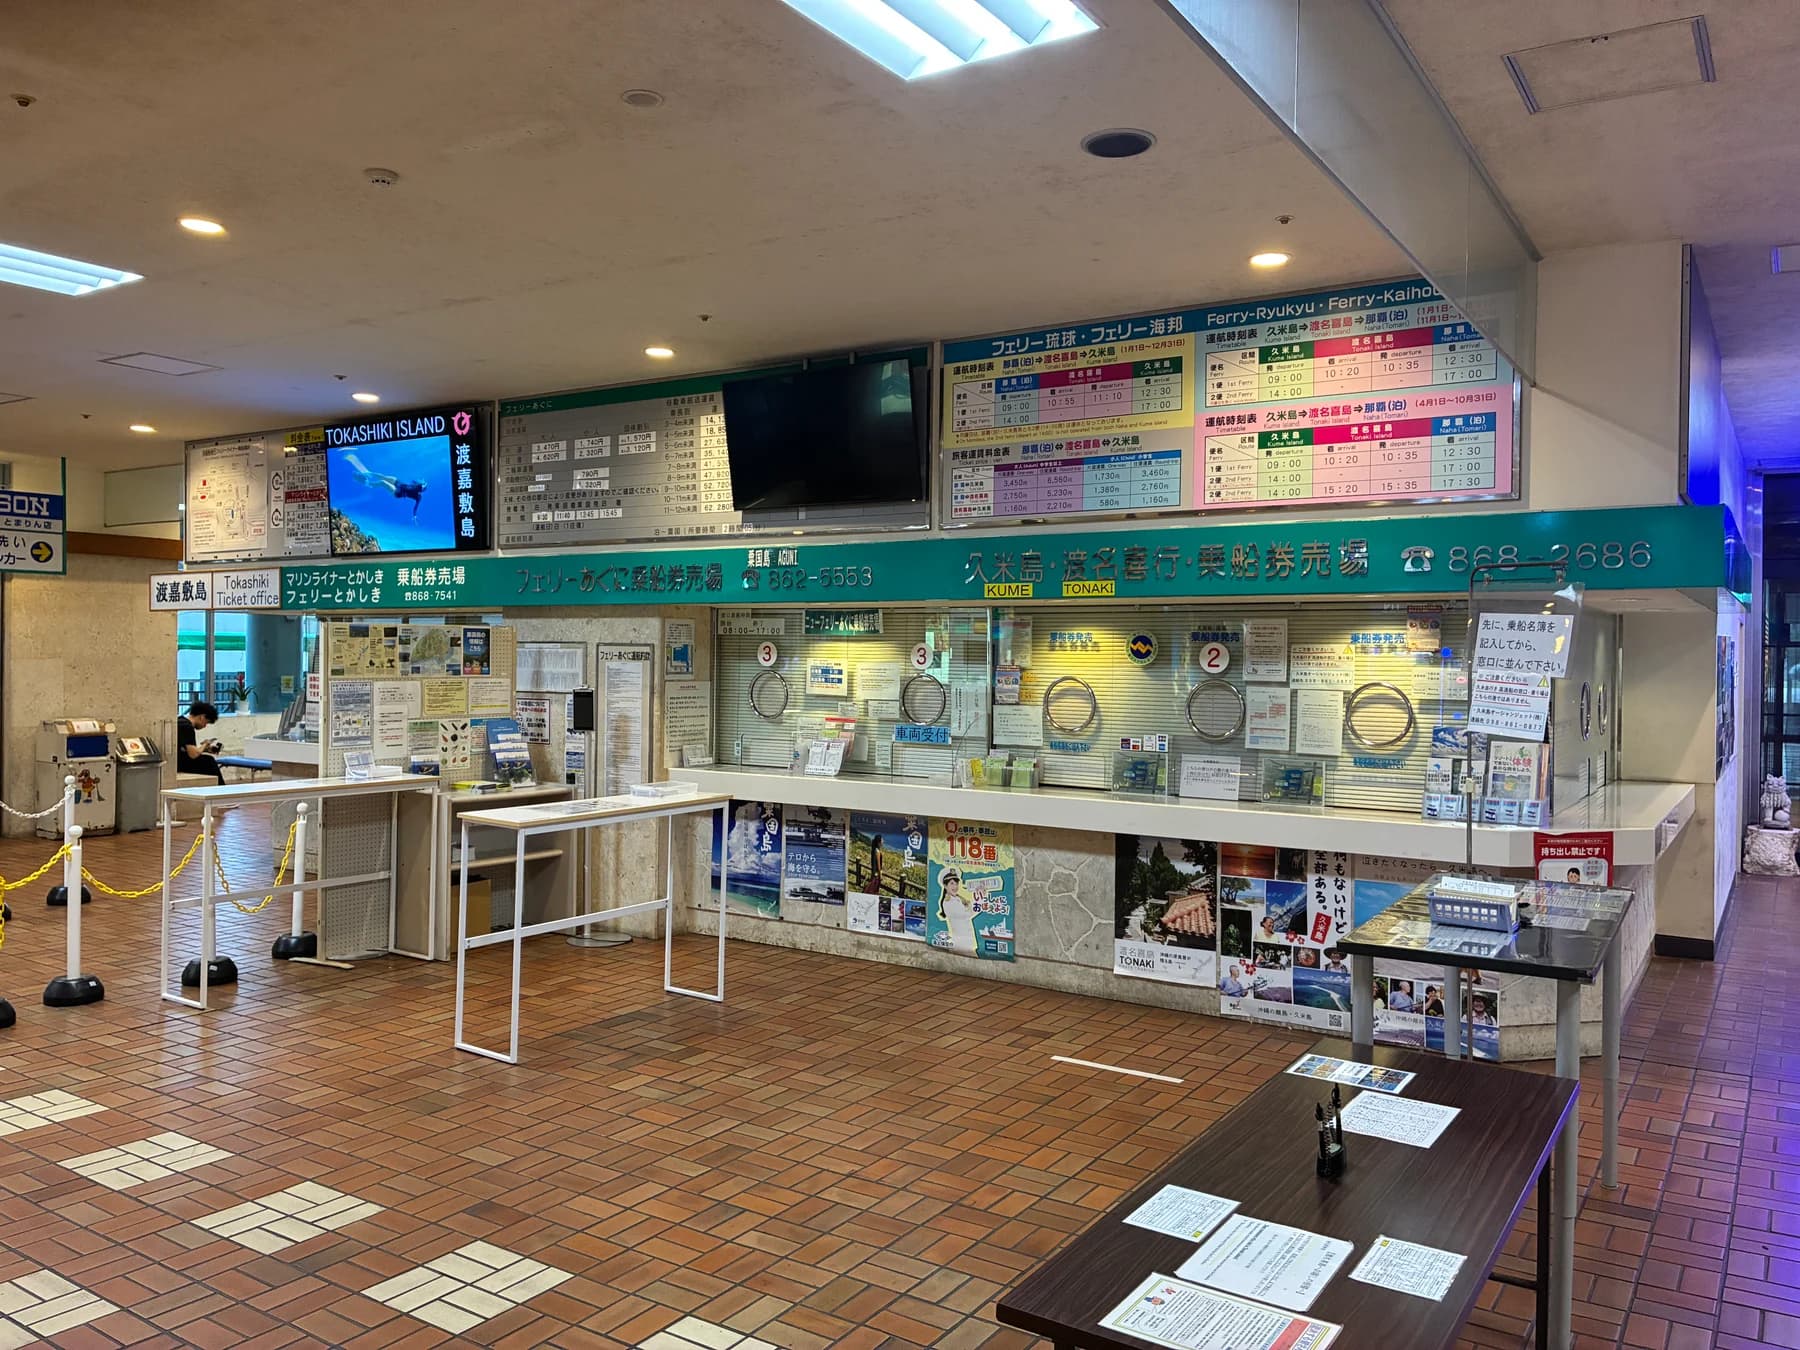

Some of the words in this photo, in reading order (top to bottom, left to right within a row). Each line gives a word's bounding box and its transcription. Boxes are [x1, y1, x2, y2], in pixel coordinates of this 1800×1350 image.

[1208, 302, 1315, 326] Ferry-Ryukyu
[991, 316, 1184, 357] フェリー琉球・フェリー海邦
[1205, 328, 1258, 344] 運航時刻表
[1266, 324, 1298, 337] 久米島
[1309, 316, 1353, 332] 渡名喜島
[1364, 308, 1408, 325] 那覇(泊)
[1216, 341, 1247, 349] Timetable
[1264, 336, 1282, 344] Kume
[1284, 333, 1301, 341] Island
[1311, 330, 1331, 338] Tonaki
[1333, 327, 1351, 335] Island
[953, 361, 995, 375] 運航時刻表
[1088, 346, 1116, 358] 久米島
[1271, 346, 1300, 356] 久米島
[1268, 373, 1302, 384] 09:00
[1325, 367, 1359, 378] 10:20
[1384, 361, 1419, 372] 10:35
[1445, 353, 1482, 365] 12:30
[1269, 387, 1302, 398] 14:00
[1445, 369, 1482, 381] 17:00
[1002, 402, 1030, 412] 09:00
[1047, 396, 1076, 407] 10:55
[1093, 391, 1122, 403] 11:10
[1141, 387, 1171, 397] 12:30
[1003, 414, 1030, 425] 14:00
[1141, 400, 1171, 411] 17:00
[1205, 413, 1257, 427] 運航時刻表
[1265, 410, 1298, 422] 久米島
[1308, 405, 1351, 418] 渡名喜島
[1364, 399, 1407, 414] 那覇(泊)
[325, 421, 393, 446] TOKASHIKI
[396, 415, 446, 438] ISLAND
[1264, 421, 1282, 429] Kume
[1440, 425, 1487, 434] Naha(Tomari)
[1111, 435, 1140, 447] 久米島
[1240, 436, 1255, 444] 区間
[1271, 432, 1300, 441] 久米島
[1267, 459, 1302, 469] 09:00
[1324, 455, 1358, 465] 10:20
[1382, 451, 1418, 461] 10:35
[1443, 447, 1481, 457] 12:30
[1268, 473, 1301, 483] 14:00
[1443, 462, 1481, 472] 17:00
[455, 443, 476, 538] 渡嘉敷島
[1268, 487, 1301, 497] 14:00
[1324, 484, 1358, 494] 15:20
[1382, 481, 1418, 491] 15:35
[1443, 477, 1481, 487] 17:30
[777, 549, 799, 567] AGUNI
[964, 538, 1370, 586] 久米島・渡名喜行・乗船券売場
[1448, 540, 1652, 574] 868-2686
[156, 579, 207, 605] 渡嘉敷島
[224, 573, 270, 590] Tokashiki
[286, 568, 384, 586] マリンライナーとかしき
[397, 567, 466, 586] 乗船券売場
[514, 562, 724, 594] フェリーあぐに乗船券売場
[216, 591, 249, 606] Ticket
[250, 590, 280, 606] office
[286, 586, 382, 605] フェリーとかしき
[986, 583, 1030, 597] KUME
[1064, 582, 1115, 595] TONAKI
[1481, 618, 1556, 633] 先に、乗船名簿を
[762, 645, 772, 662] 3
[916, 647, 927, 665] 3
[1479, 638, 1537, 652] 記入してから、
[1207, 648, 1221, 668] 2
[1476, 655, 1565, 674] 窓口に並んで下さい。
[895, 726, 949, 743] 車両受付
[787, 853, 817, 863] テロから
[946, 835, 999, 861] 118番
[1313, 850, 1329, 910] 全部ある。
[1333, 852, 1347, 934] 何もないけど
[1119, 955, 1155, 969] TONAKI
